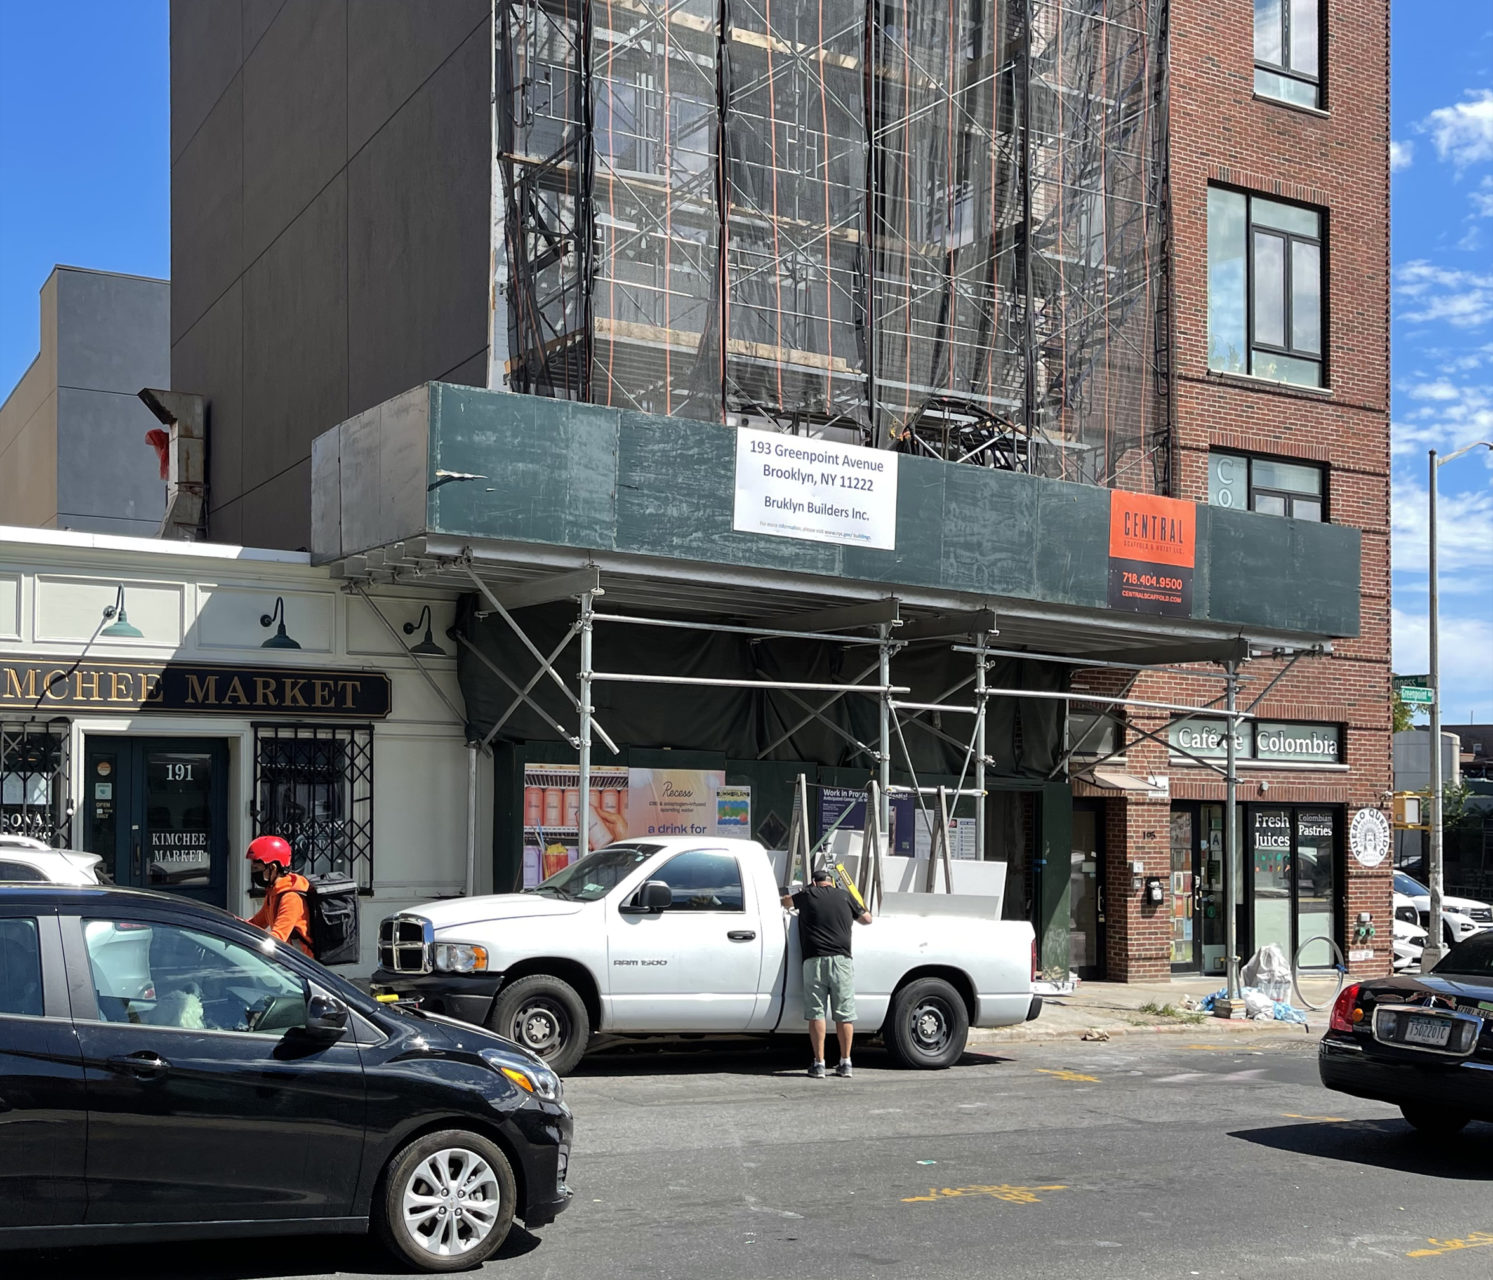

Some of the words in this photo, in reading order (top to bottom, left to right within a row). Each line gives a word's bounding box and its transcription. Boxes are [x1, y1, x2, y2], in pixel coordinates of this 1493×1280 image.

[750, 440, 772, 455] 193
[774, 444, 840, 466] Greenpoint
[842, 455, 884, 472] Avenue
[763, 464, 817, 486] Brooklyn,
[820, 472, 837, 486] NY
[839, 475, 874, 492] 11222
[764, 495, 804, 514] Bruklyn
[807, 502, 849, 518] Builders
[851, 507, 870, 521] Inc.
[1124, 511, 1183, 544] CENTRAL
[1122, 571, 1182, 590] 718.404.9500
[184, 674, 361, 709] MARKET
[1179, 727, 1217, 748] Café
[1257, 731, 1338, 755] Colombia
[166, 764, 194, 781] 191
[663, 781, 693, 798] Recess
[1255, 812, 1289, 828] Fresh
[1298, 813, 1333, 822] Colombian
[648, 825, 655, 834] a
[657, 823, 688, 834] drink
[690, 823, 707, 834] for
[1298, 825, 1333, 836] Pastries
[1351, 811, 1366, 857] PUEBLO
[1368, 809, 1388, 856] QUERIDO
[152, 833, 206, 846] KIMCHEE
[1254, 832, 1290, 849] Juices
[154, 850, 203, 863] MARKET
